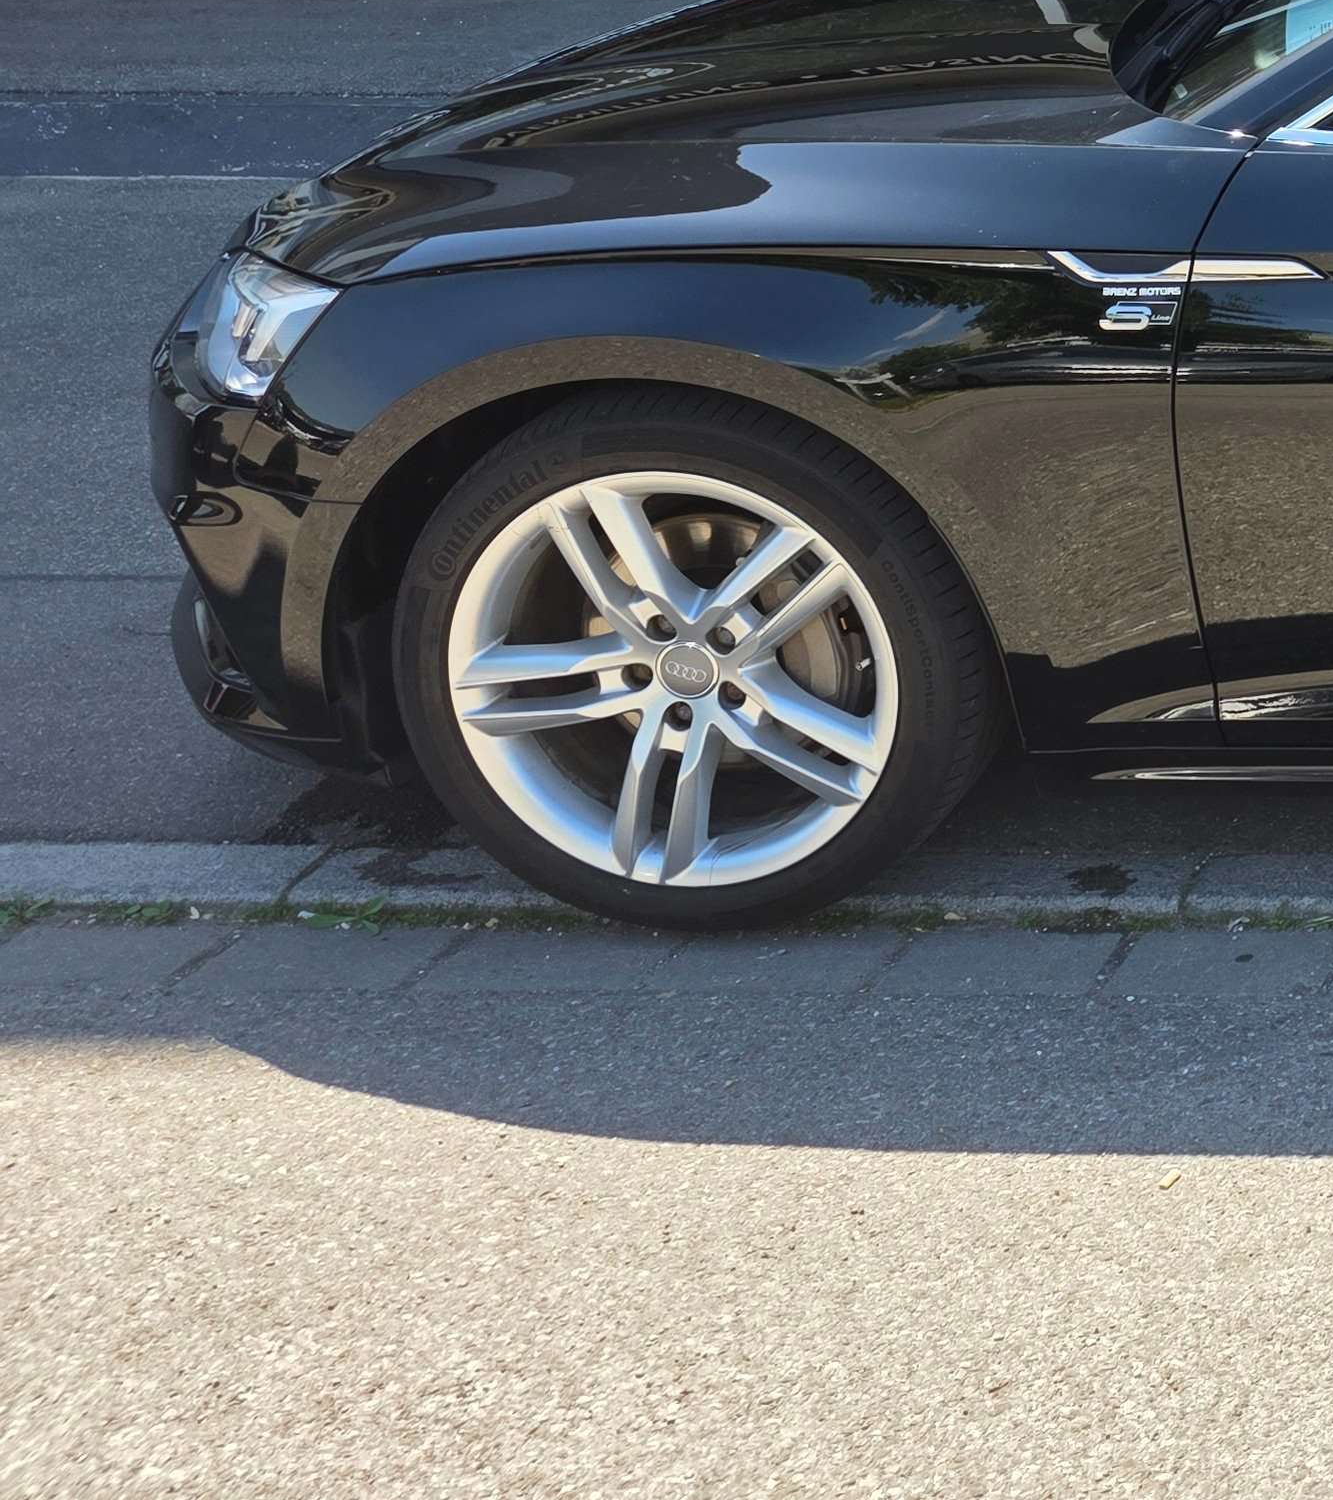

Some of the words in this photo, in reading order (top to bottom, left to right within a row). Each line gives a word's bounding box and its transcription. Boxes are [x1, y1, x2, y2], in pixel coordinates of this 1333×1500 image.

[1102, 286, 1138, 297] BRENZ
[1139, 286, 1181, 297] MOTORS
[1098, 305, 1153, 331] S
[429, 458, 549, 582] Continental
